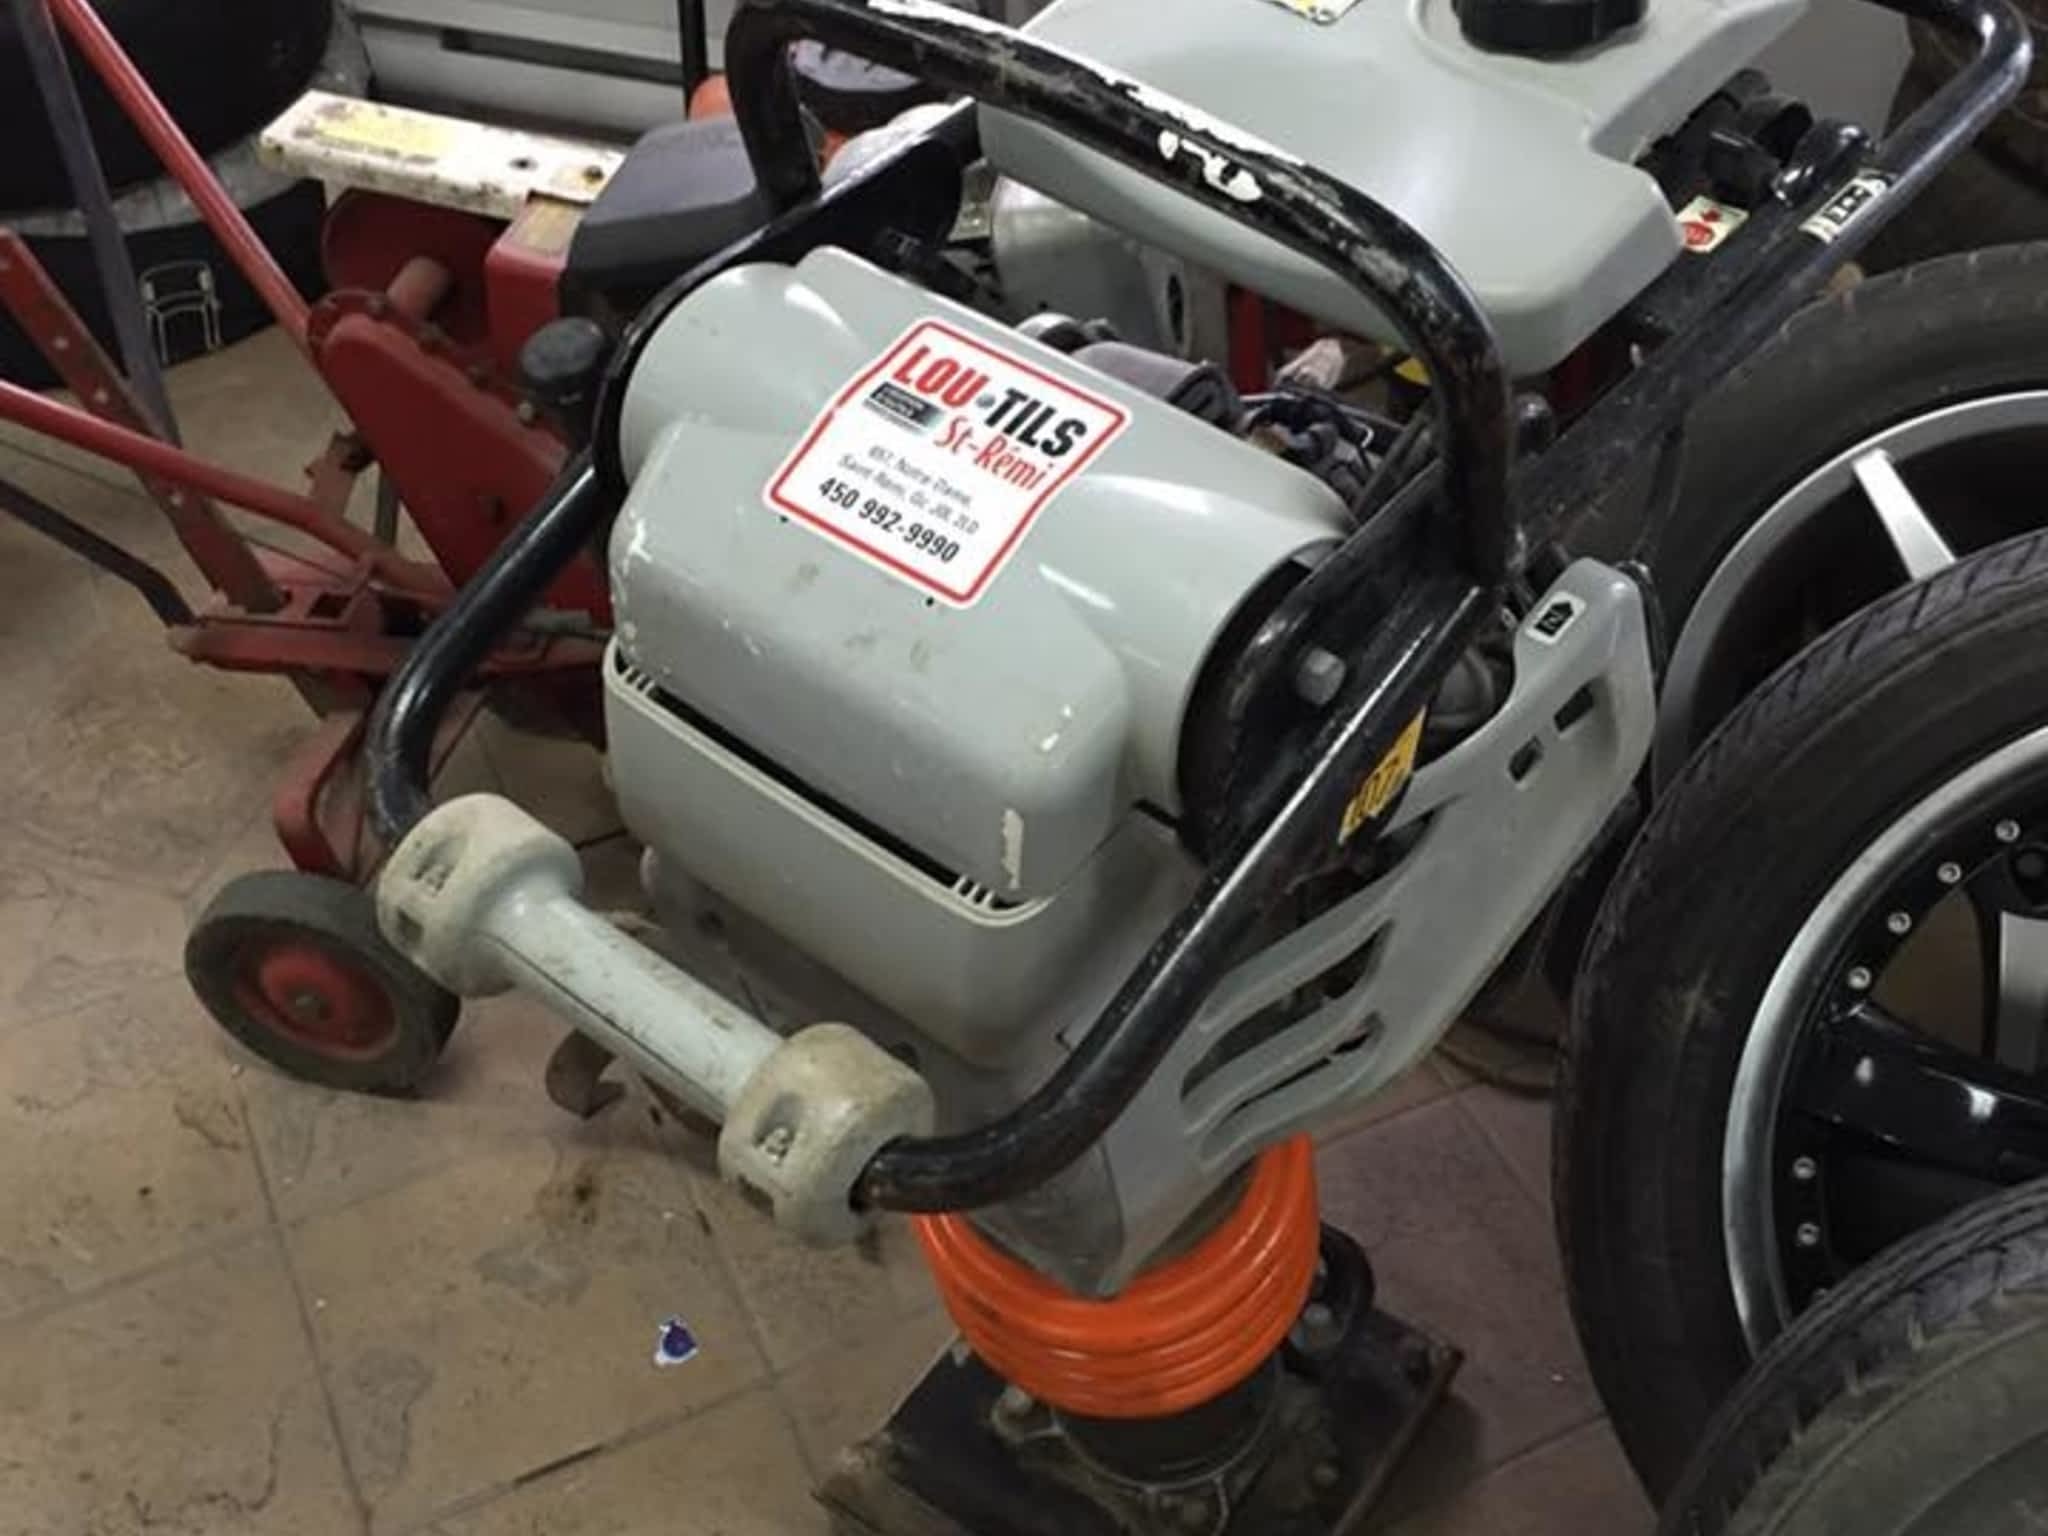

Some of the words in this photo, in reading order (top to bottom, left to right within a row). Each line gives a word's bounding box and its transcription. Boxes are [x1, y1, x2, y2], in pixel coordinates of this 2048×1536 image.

[892, 345, 990, 408] LOU
[984, 387, 1088, 458] TILS
[933, 415, 1054, 491] St-Rémi
[818, 476, 861, 510] 450
[858, 497, 961, 564] 992-9990
